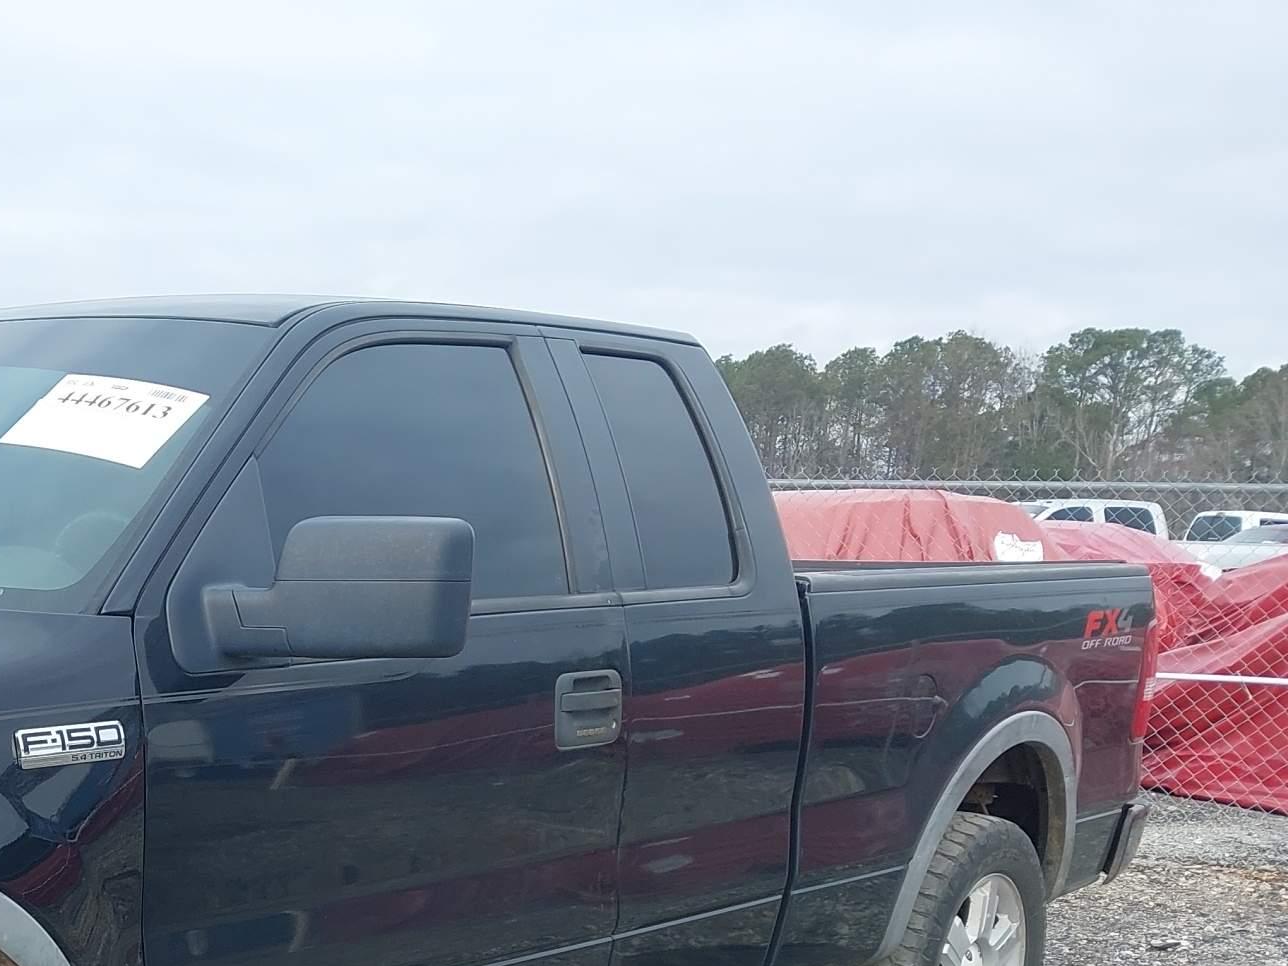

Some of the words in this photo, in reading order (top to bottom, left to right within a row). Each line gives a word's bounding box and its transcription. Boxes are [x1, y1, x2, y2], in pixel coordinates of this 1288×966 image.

[57, 391, 172, 419] 44467613
[1084, 607, 1134, 639] FX4
[1081, 638, 1102, 650] OFF
[1104, 635, 1132, 648] ROAD
[21, 724, 123, 755] F-150
[88, 750, 123, 760] TRITON
